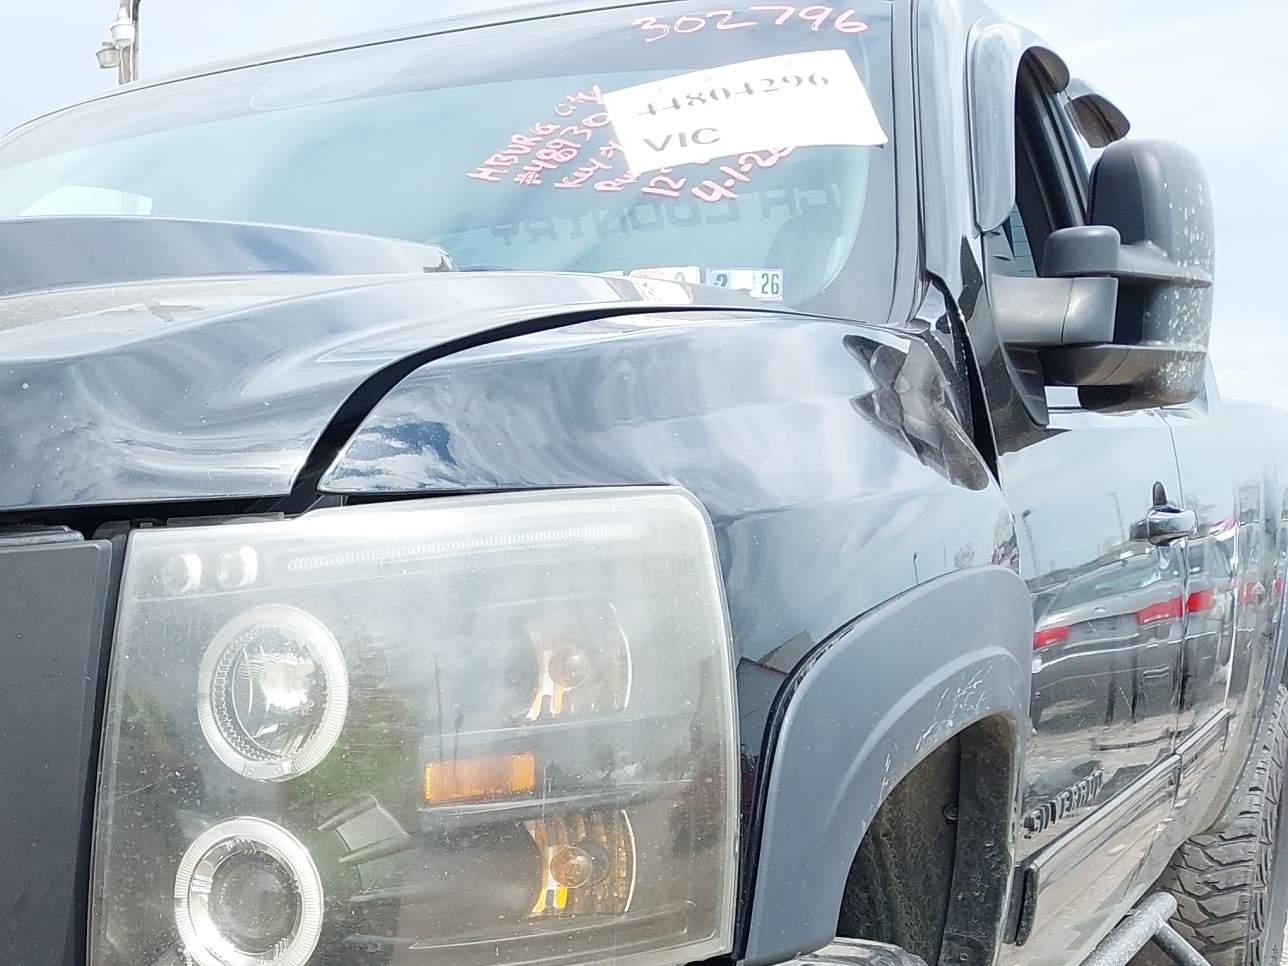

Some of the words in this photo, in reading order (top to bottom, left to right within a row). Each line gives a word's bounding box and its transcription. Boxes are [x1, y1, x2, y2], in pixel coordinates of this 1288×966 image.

[631, 5, 869, 42] 302796
[642, 127, 721, 152] VIC
[761, 273, 780, 295] 26
